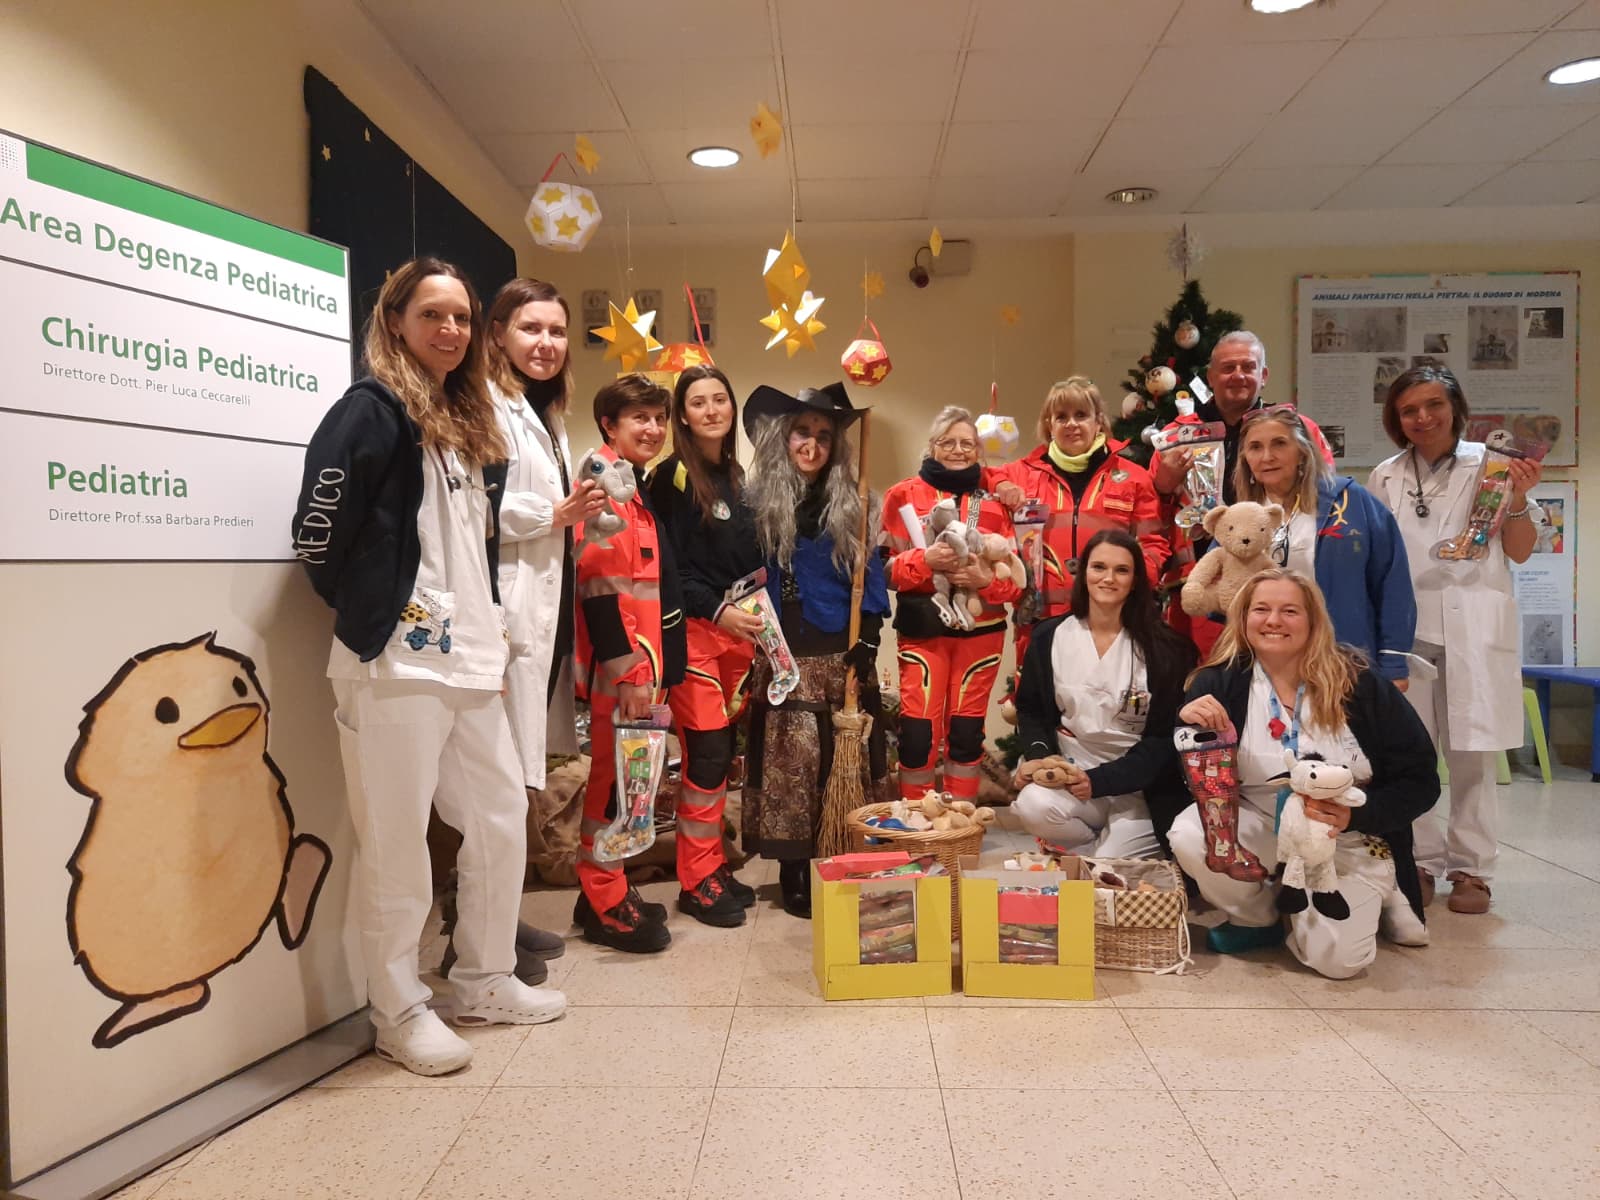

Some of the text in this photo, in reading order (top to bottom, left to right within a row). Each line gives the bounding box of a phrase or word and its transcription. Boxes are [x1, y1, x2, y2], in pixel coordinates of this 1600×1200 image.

[0, 197, 338, 314] Area Degenza Pediatrica
[41, 316, 319, 392] Chirurgia Pediatrica
[43, 362, 251, 406] Direttore Dott. Pier Luca Ceccarelli
[47, 461, 188, 498] Pediatria
[49, 508, 254, 528] Direttore Prof.ssa Barbara Predieri
[296, 468, 345, 564] MEDICO
